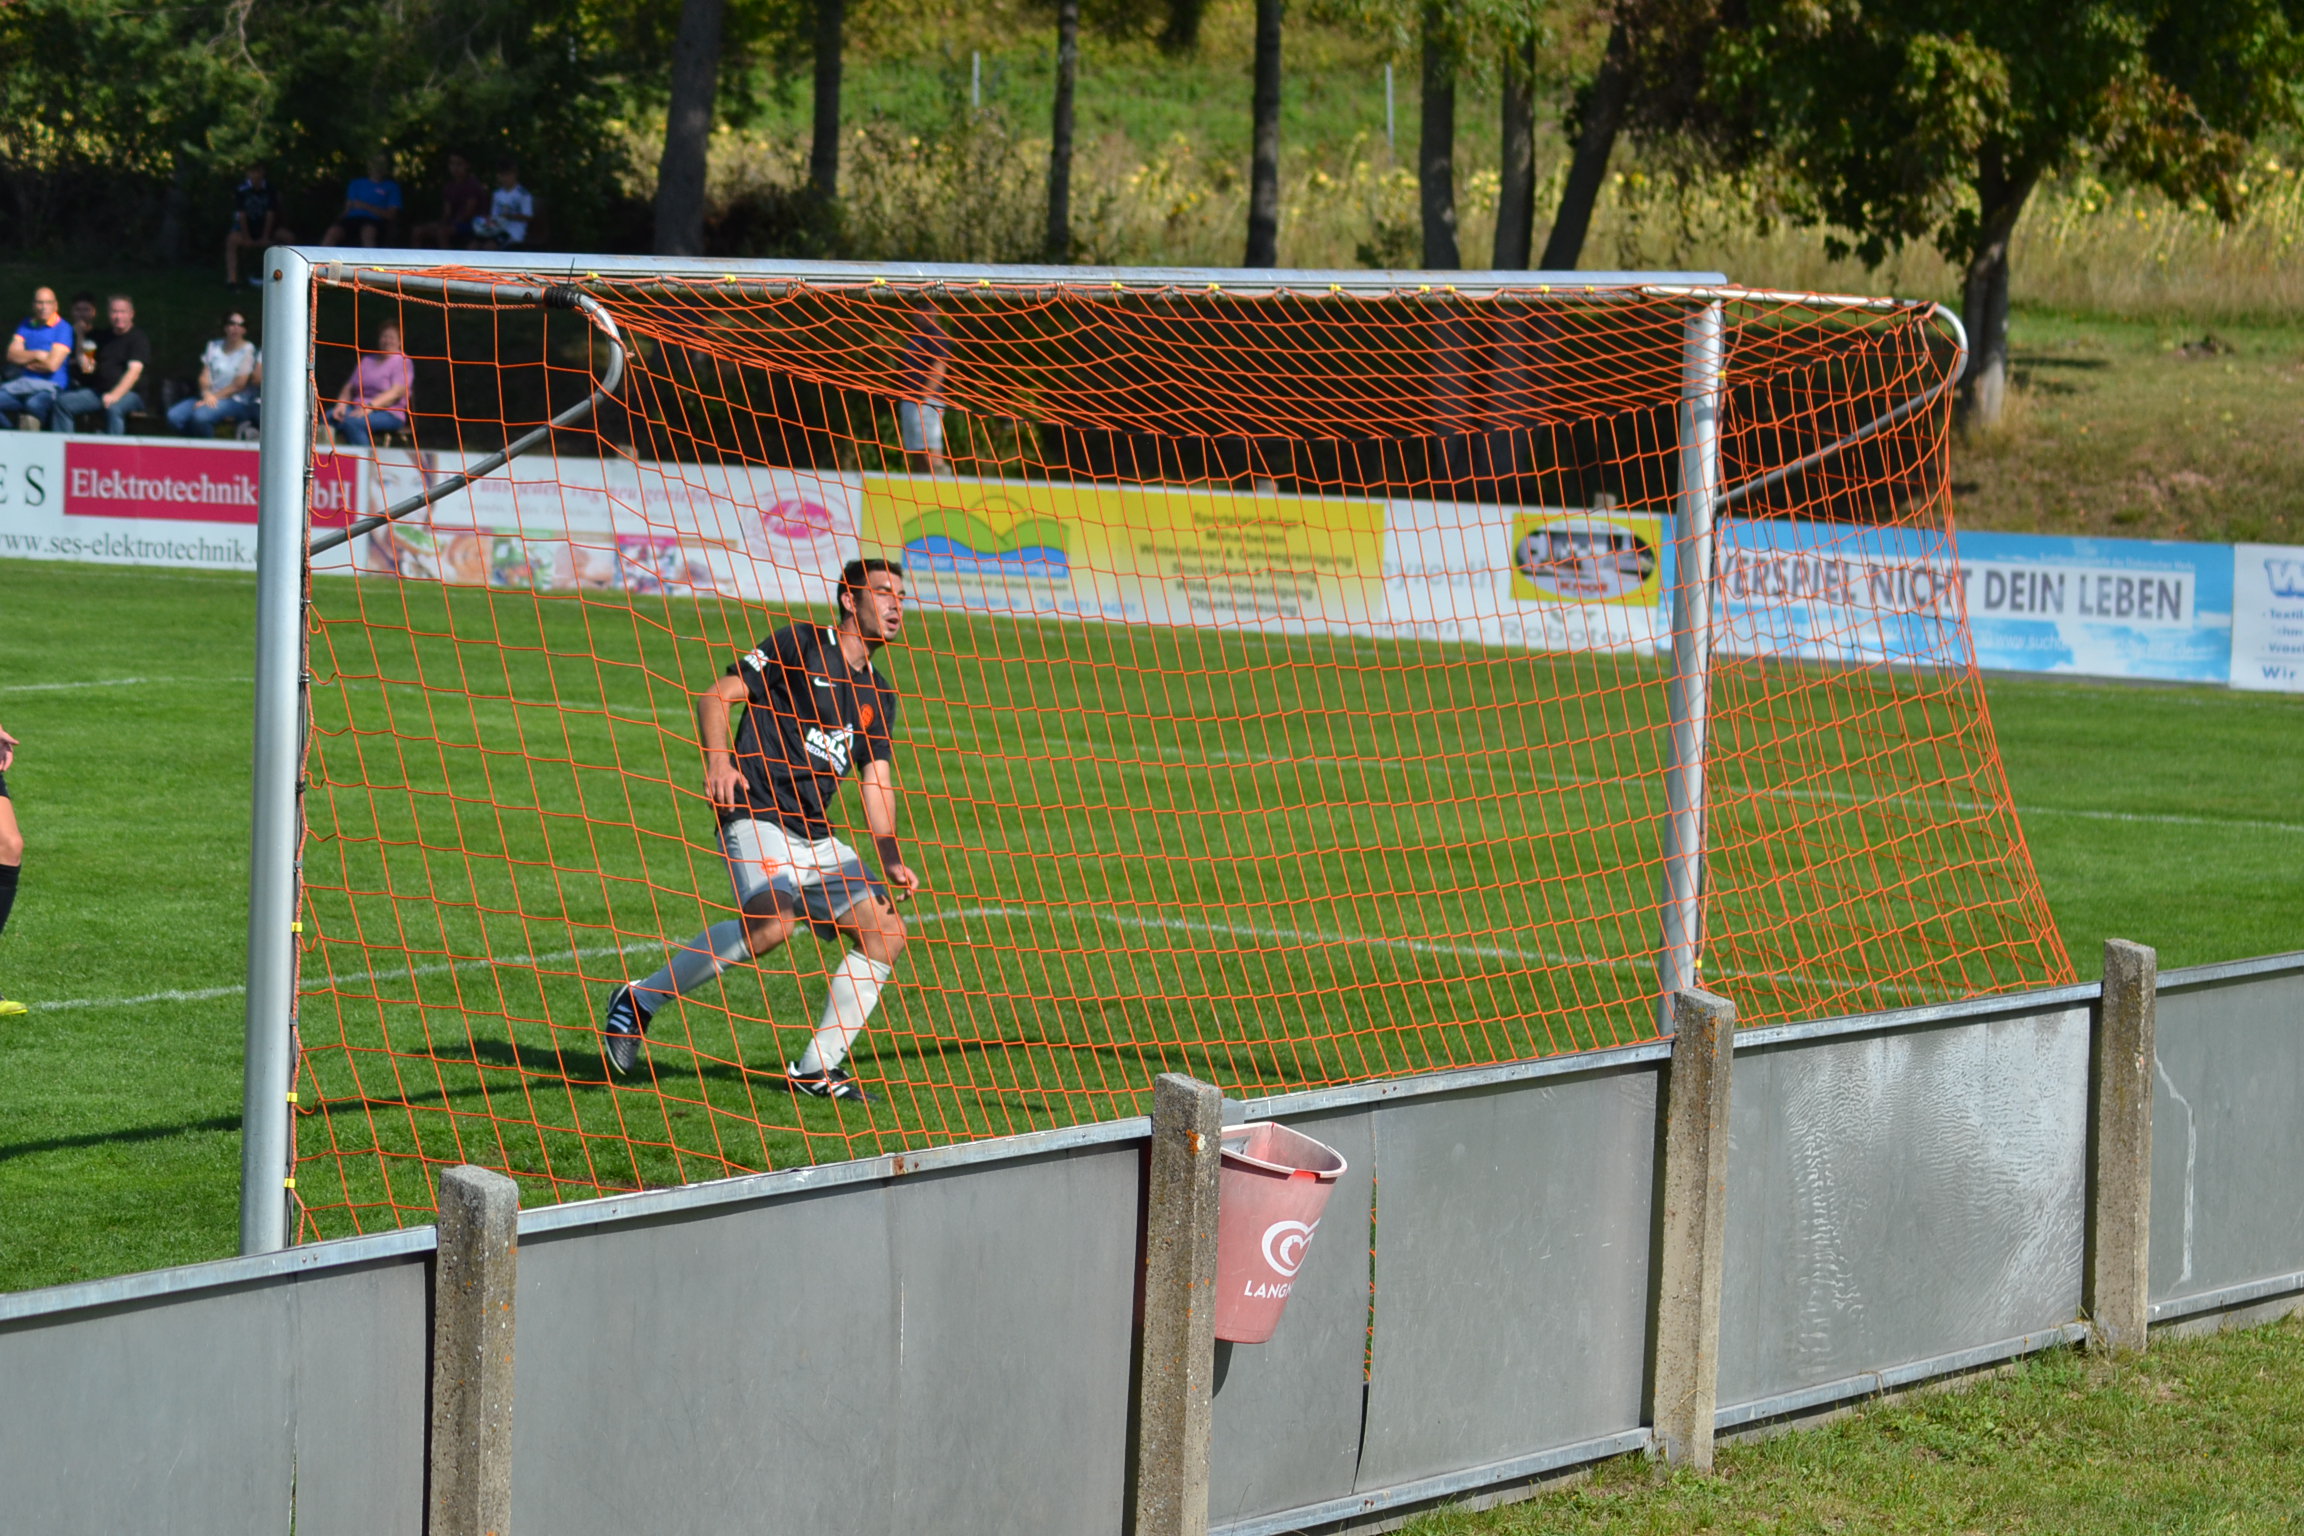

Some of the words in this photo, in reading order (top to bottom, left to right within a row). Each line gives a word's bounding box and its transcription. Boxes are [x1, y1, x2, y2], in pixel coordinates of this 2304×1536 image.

[71, 467, 257, 505] Elektrotechnik
[0, 532, 258, 564] ww.ses-elektrotechnik.
[1871, 563, 1973, 611] NICHT
[1983, 568, 2065, 615] DEIN
[2078, 573, 2182, 622] LEBEN
[2262, 665, 2296, 679] Wir
